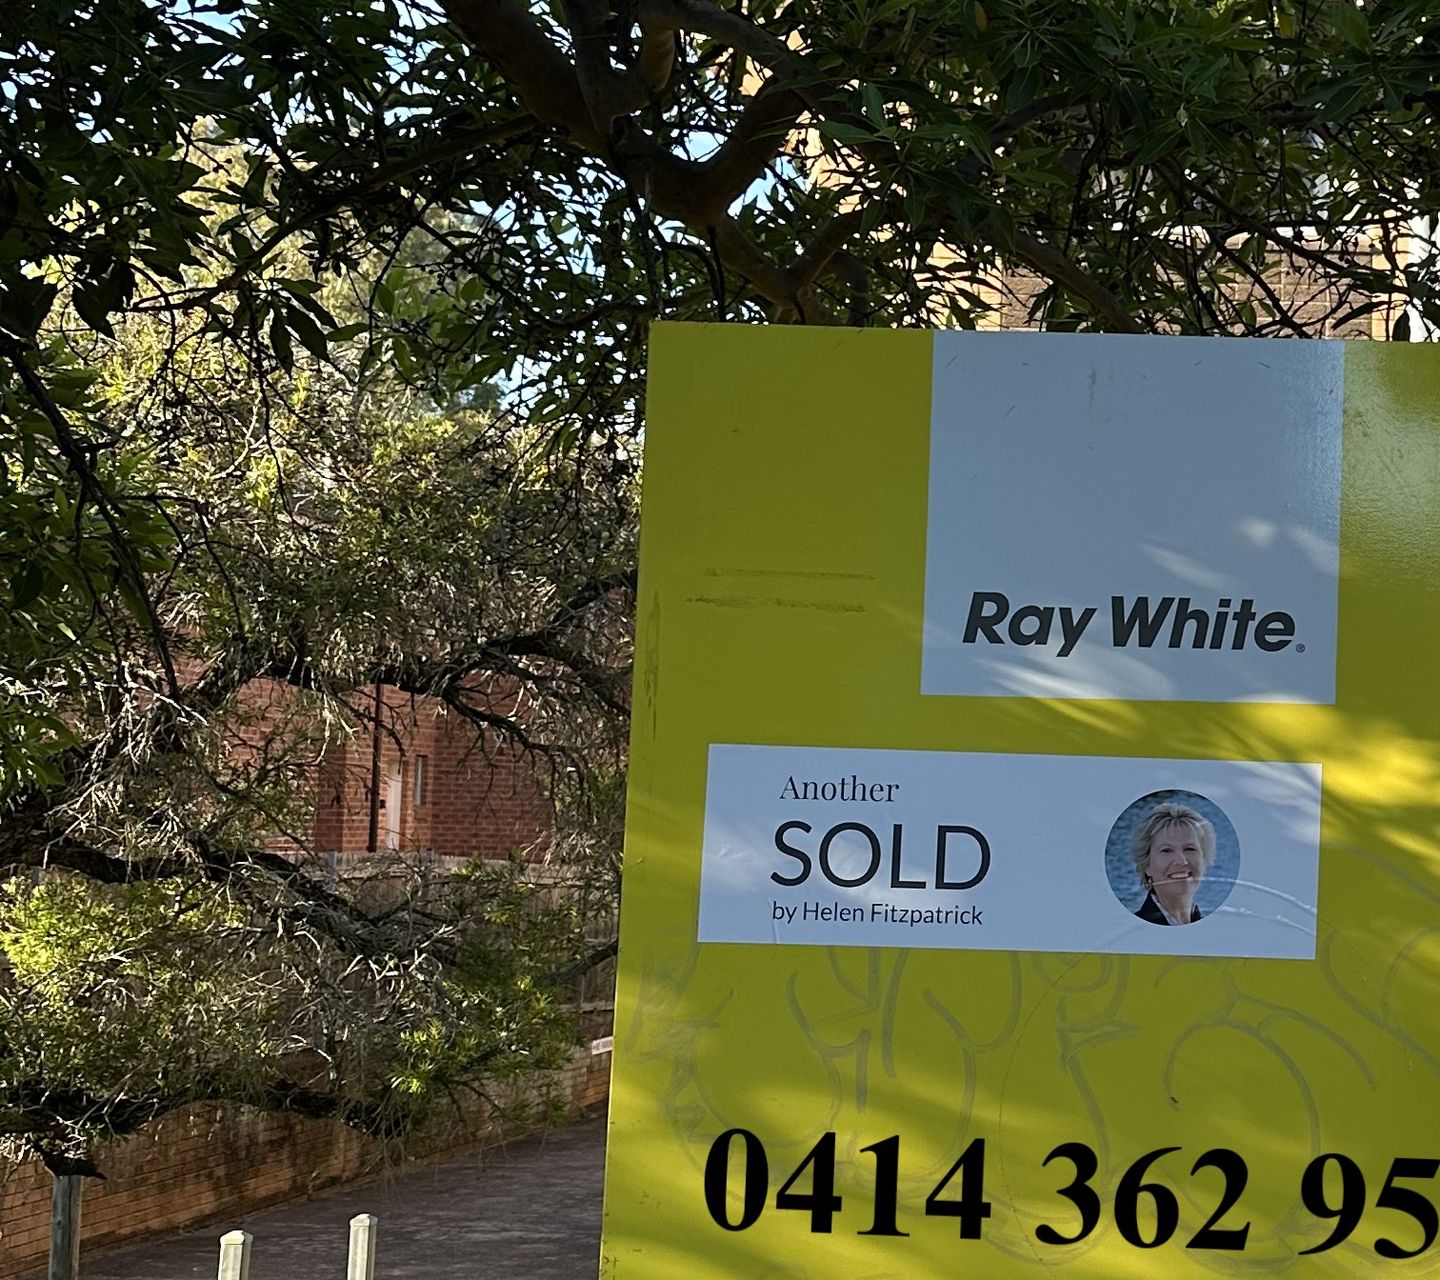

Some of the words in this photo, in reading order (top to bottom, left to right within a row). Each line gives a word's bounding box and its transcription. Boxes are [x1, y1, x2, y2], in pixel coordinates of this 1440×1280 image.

[962, 592, 1097, 657] Ray
[1111, 596, 1296, 652] White
[780, 775, 899, 802] Another
[770, 821, 990, 890] SOLD
[771, 900, 797, 925] by
[803, 901, 864, 923] Helen
[870, 903, 983, 927] Fitzpatrick
